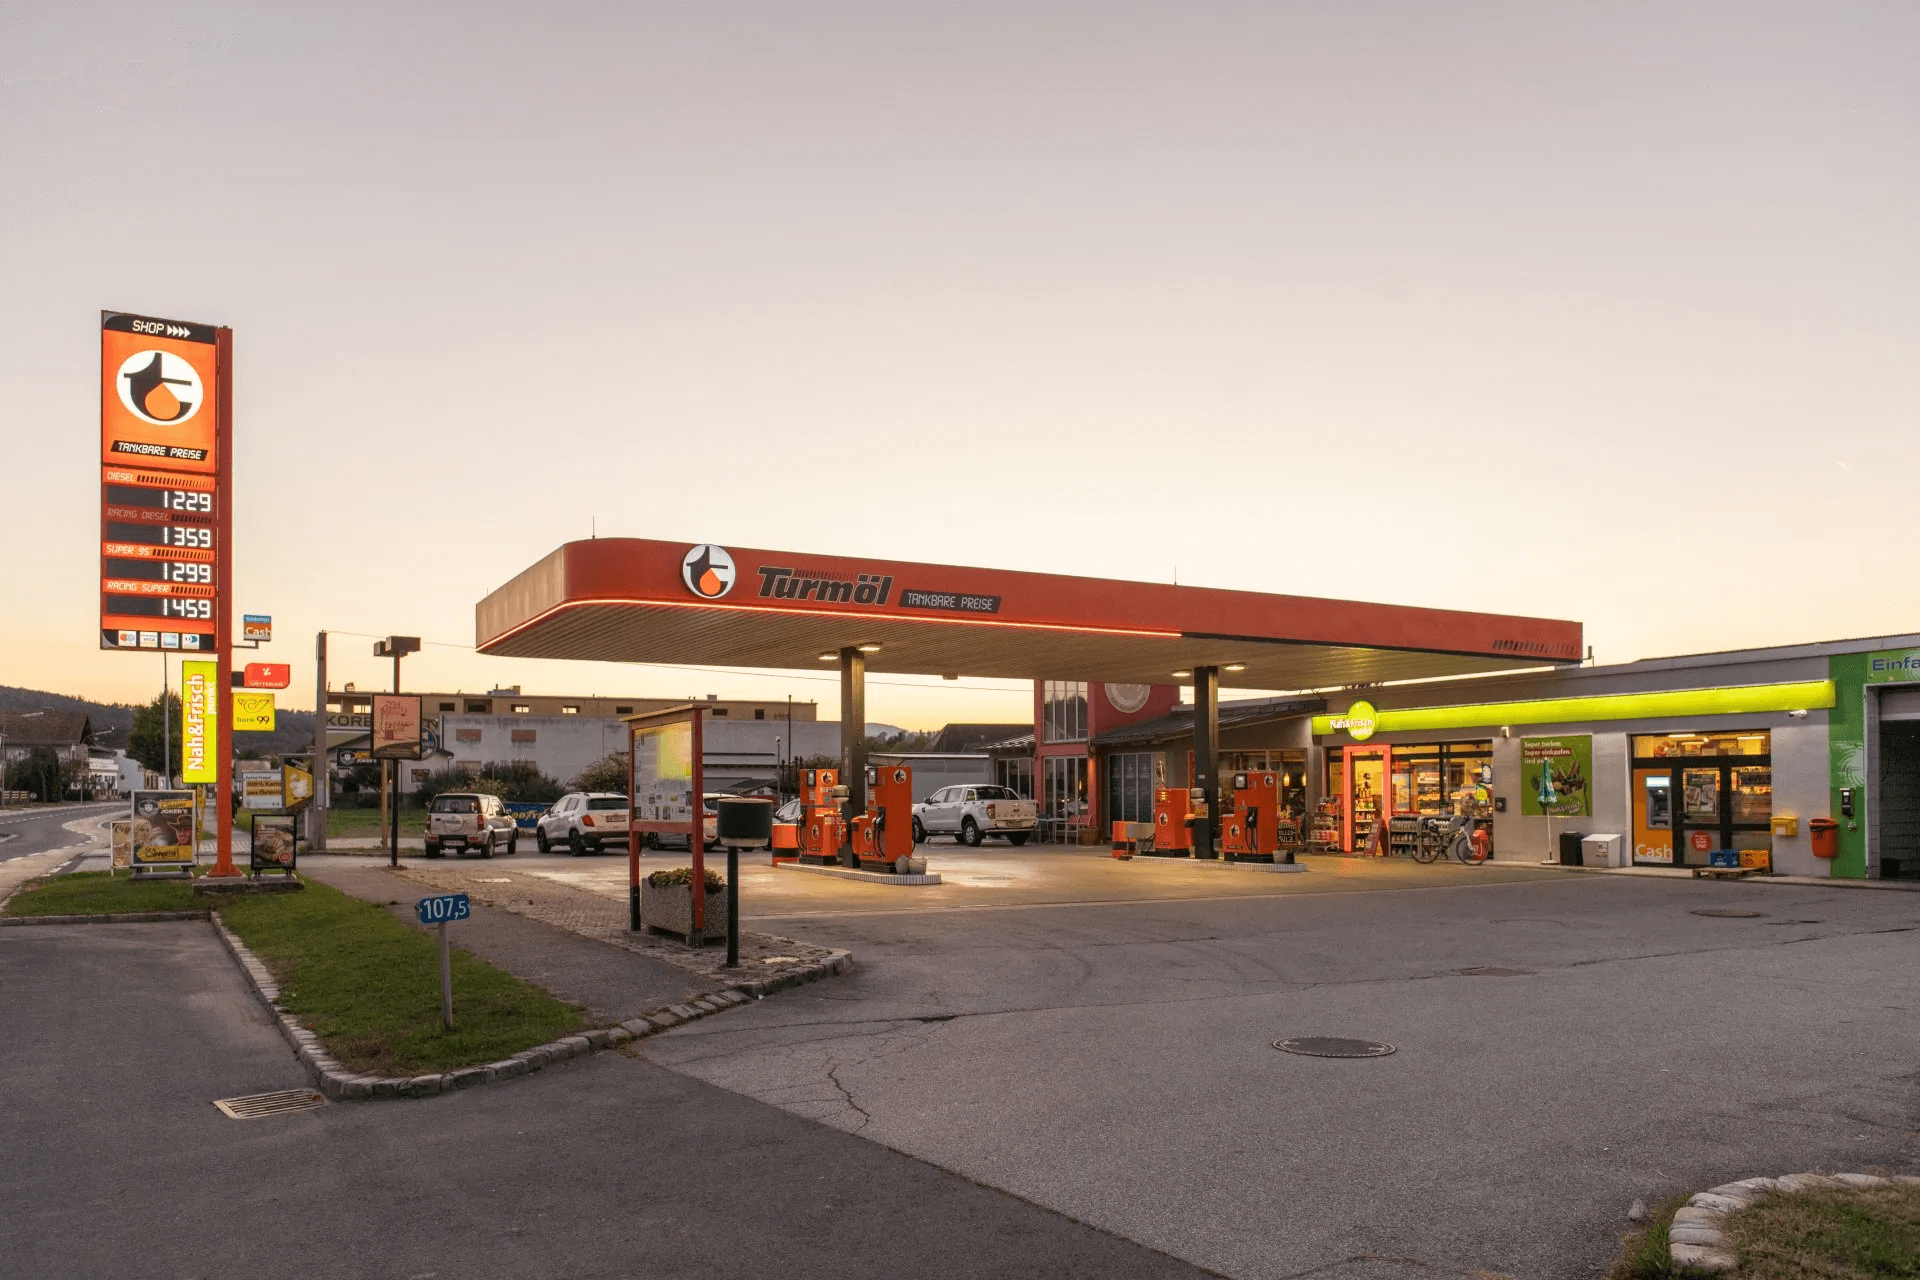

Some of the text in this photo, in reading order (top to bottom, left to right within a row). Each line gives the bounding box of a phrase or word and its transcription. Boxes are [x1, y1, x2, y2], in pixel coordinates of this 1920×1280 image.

[132, 320, 165, 334] SHOP
[118, 442, 203, 459] TANKBARE PREISE
[107, 472, 135, 482] DIESEL
[163, 490, 211, 512] 1229
[107, 508, 169, 522] RACING DIESEL
[163, 526, 211, 548] 1359
[106, 544, 134, 555] SUPER
[163, 562, 211, 583] 1299
[107, 582, 169, 593] RACING SUPER
[757, 565, 894, 606] Turmöl
[163, 598, 211, 619] 1459
[907, 592, 993, 610] TANKBARE PREISE
[245, 626, 271, 637] Cash
[186, 674, 204, 771] Nah&Frisch
[1636, 843, 1672, 859] Cash
[423, 898, 467, 919] 107,5
